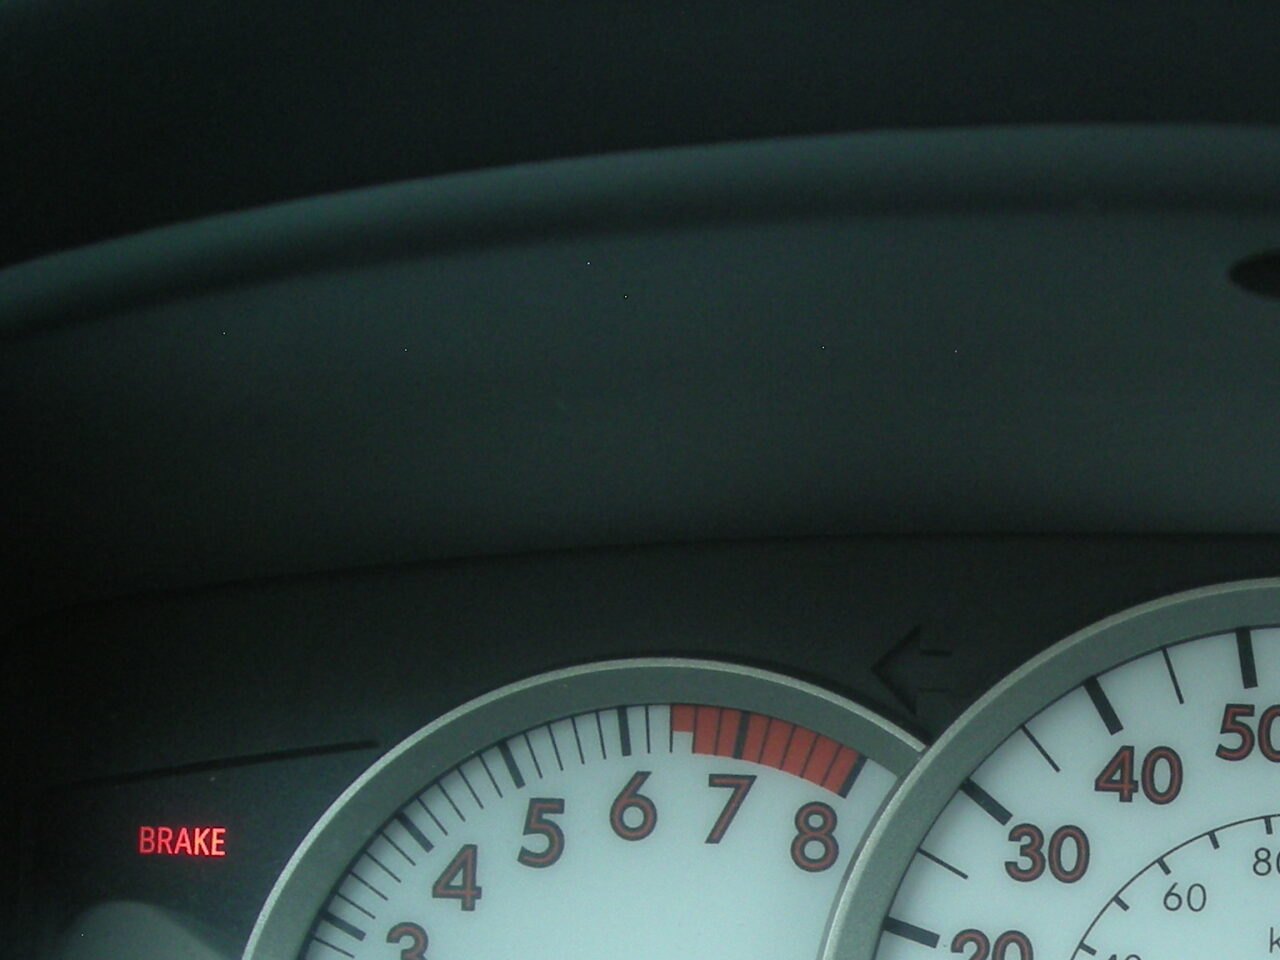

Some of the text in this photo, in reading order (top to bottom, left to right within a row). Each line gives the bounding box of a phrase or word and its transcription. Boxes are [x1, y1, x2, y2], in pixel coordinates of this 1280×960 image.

[609, 770, 658, 841] 6
[705, 773, 757, 844] 7
[1094, 745, 1183, 805] 40
[138, 825, 227, 857] BRAKE
[517, 797, 566, 869] 5
[790, 802, 839, 872] 8
[1004, 823, 1090, 884] 30
[431, 844, 483, 911] 4
[1162, 882, 1207, 912] 60
